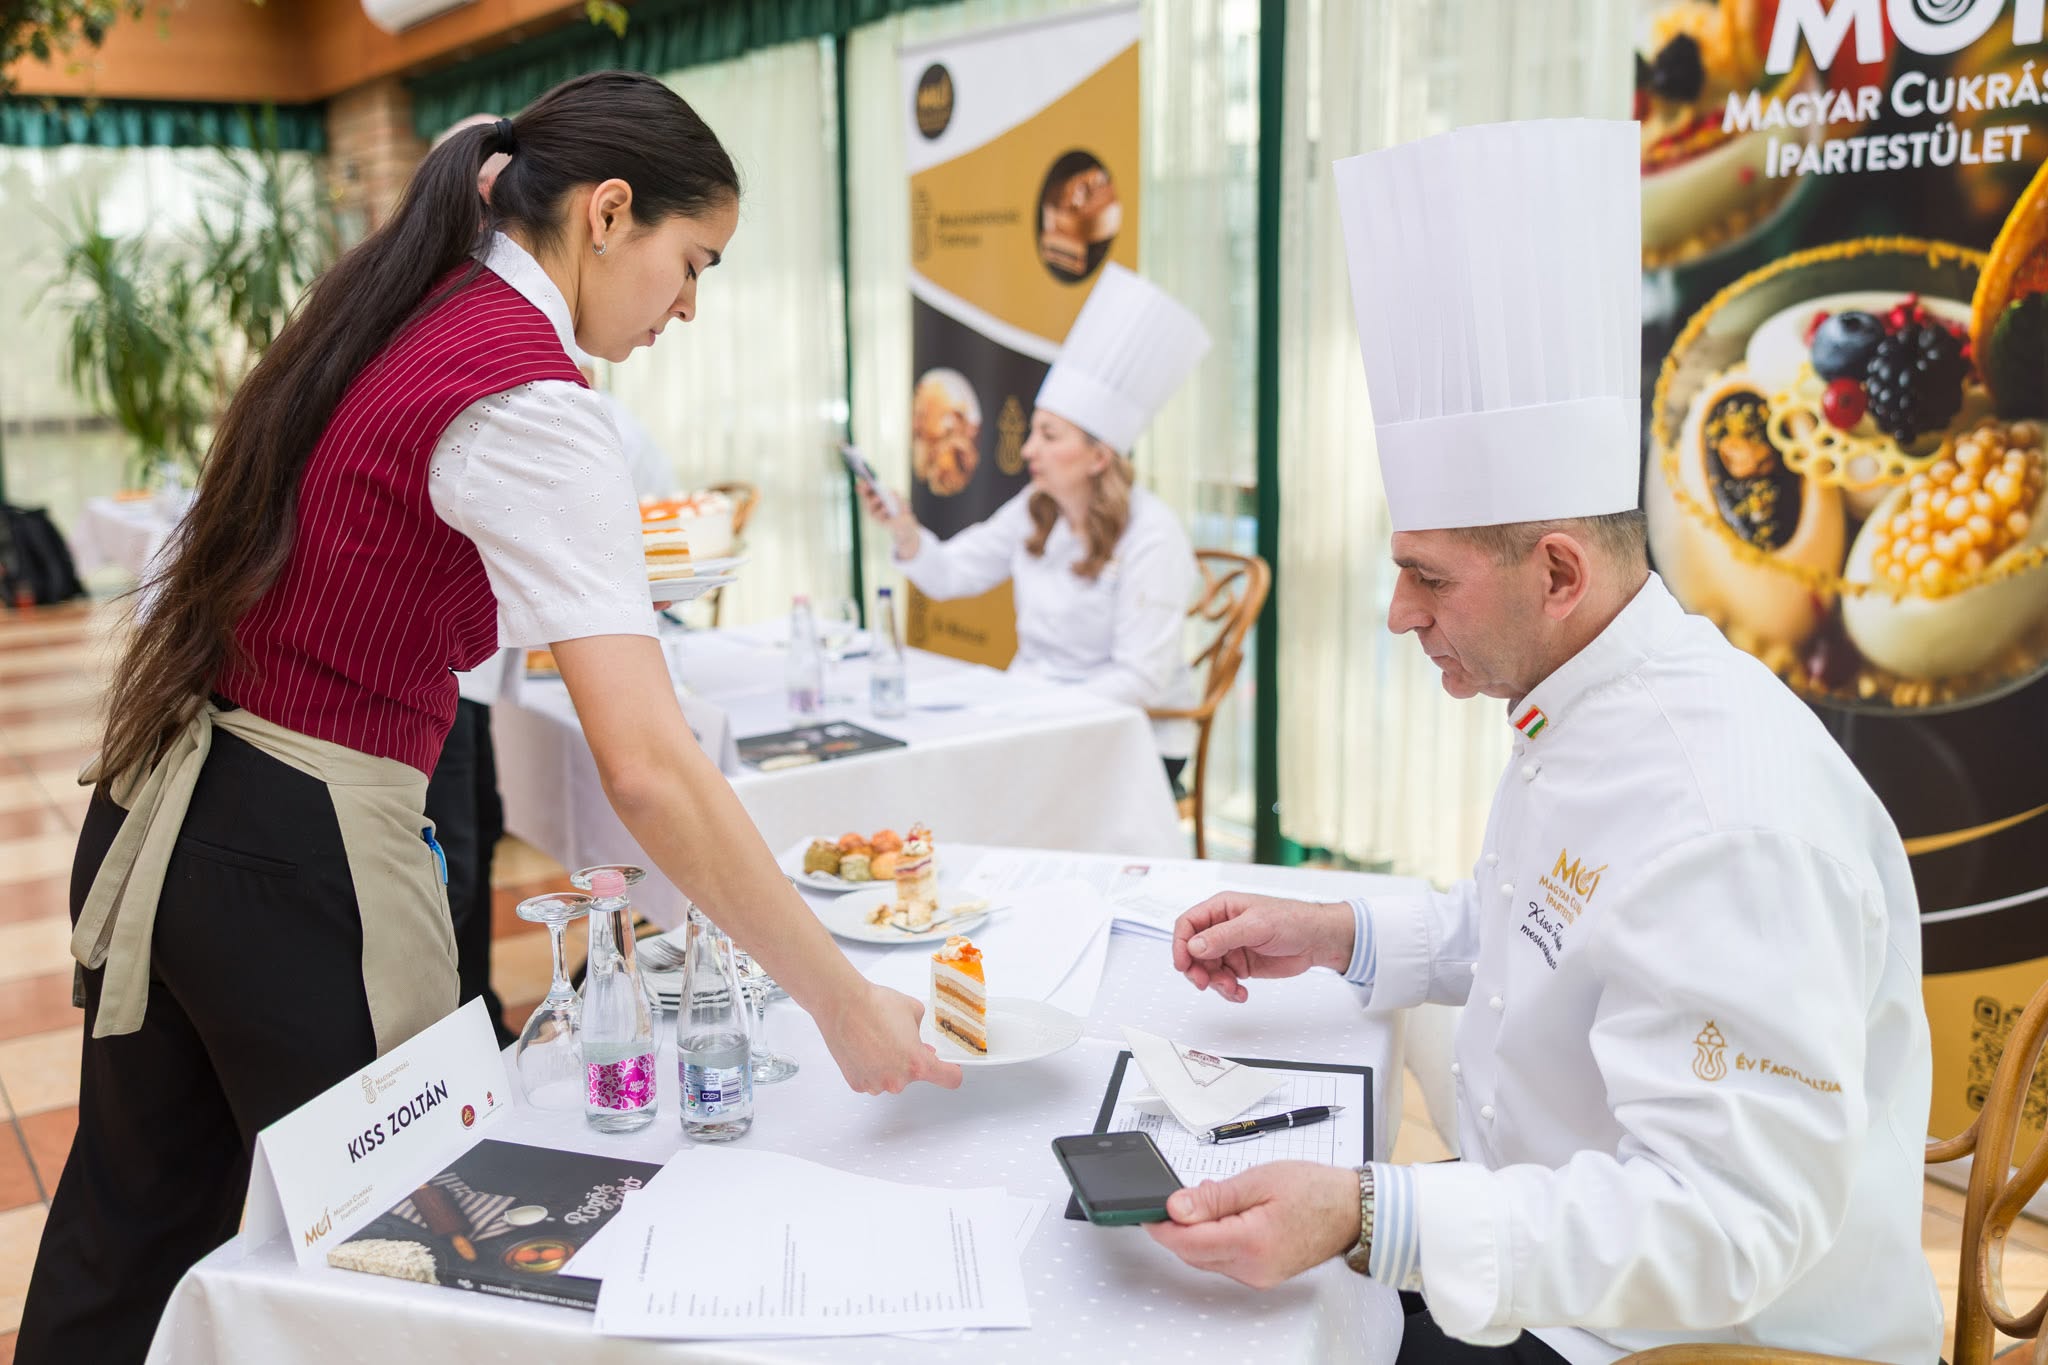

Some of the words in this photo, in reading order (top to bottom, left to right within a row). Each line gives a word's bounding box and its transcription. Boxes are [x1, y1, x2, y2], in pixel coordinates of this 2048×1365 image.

[1722, 86, 1882, 134] MAGYAR
[1766, 122, 2030, 178] IPARTESTÜLET
[1736, 1052, 1756, 1071] ÉV
[348, 1123, 386, 1163] KISS
[387, 1080, 448, 1136] ZOLTÁN
